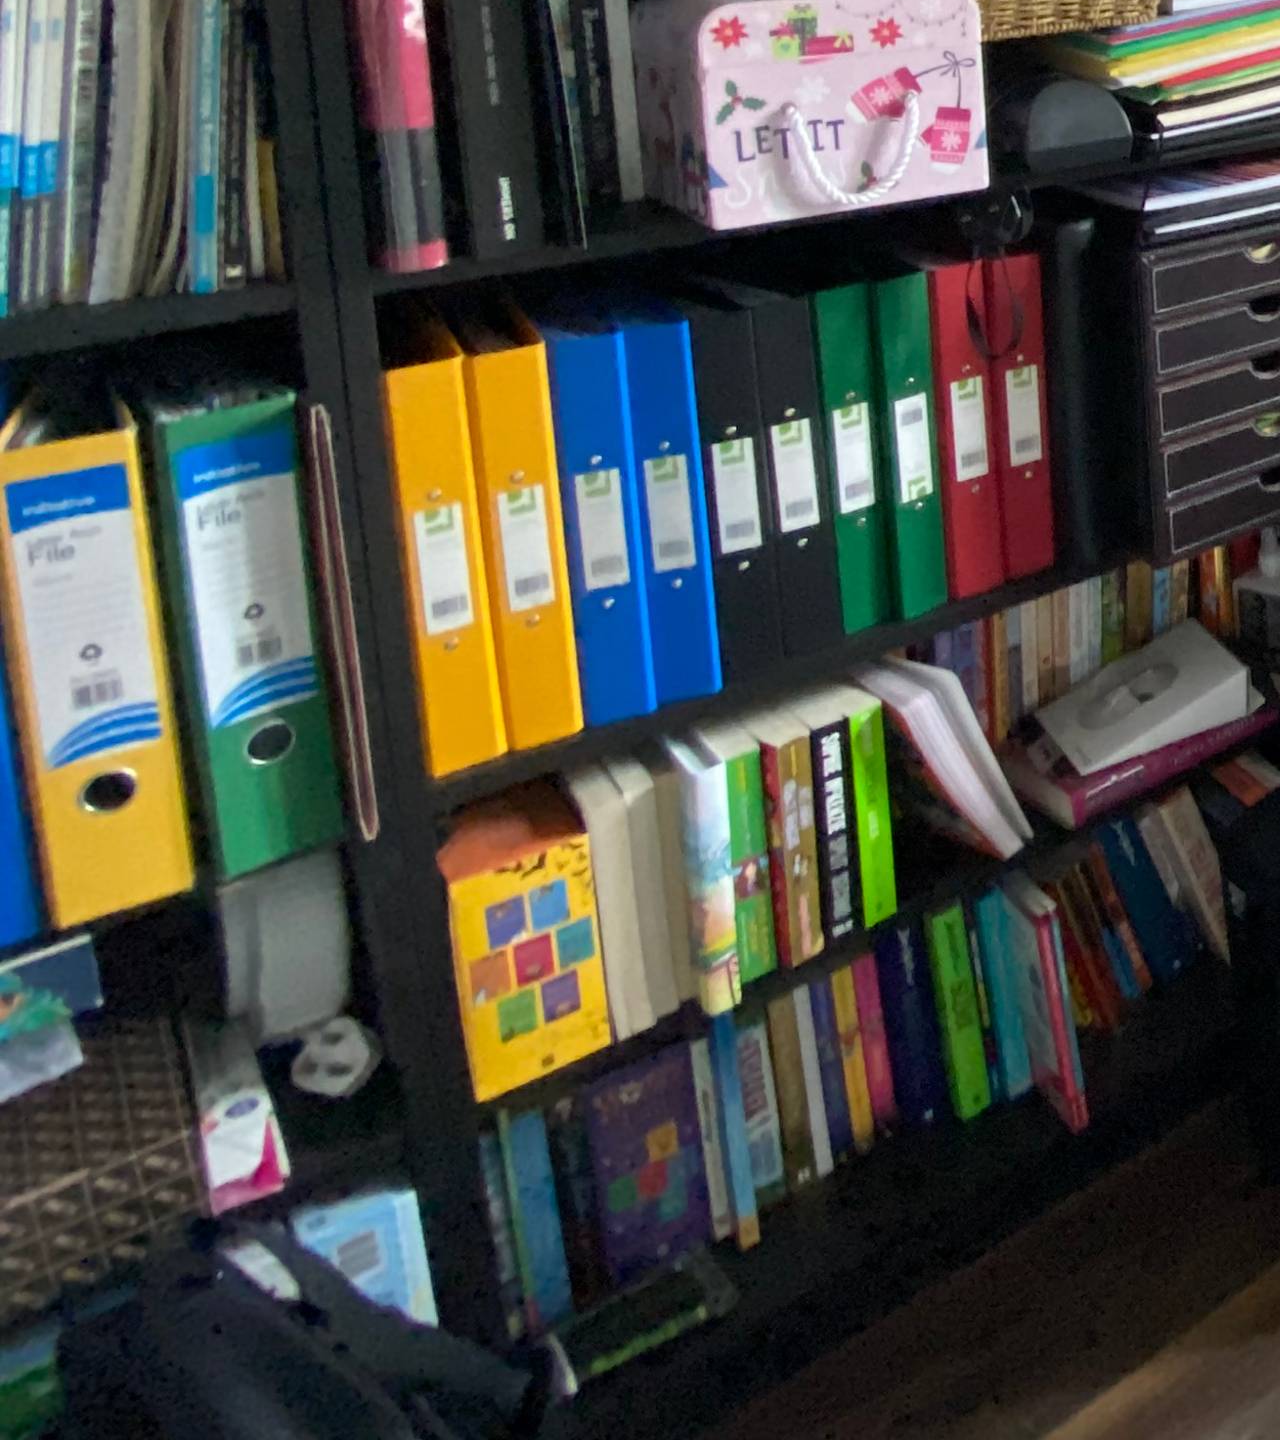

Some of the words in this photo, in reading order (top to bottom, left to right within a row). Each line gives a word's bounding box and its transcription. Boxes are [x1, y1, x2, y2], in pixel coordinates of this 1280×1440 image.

[733, 126, 791, 164] LET
[807, 118, 846, 152] IT
[196, 509, 242, 531] File
[27, 545, 77, 568] File
